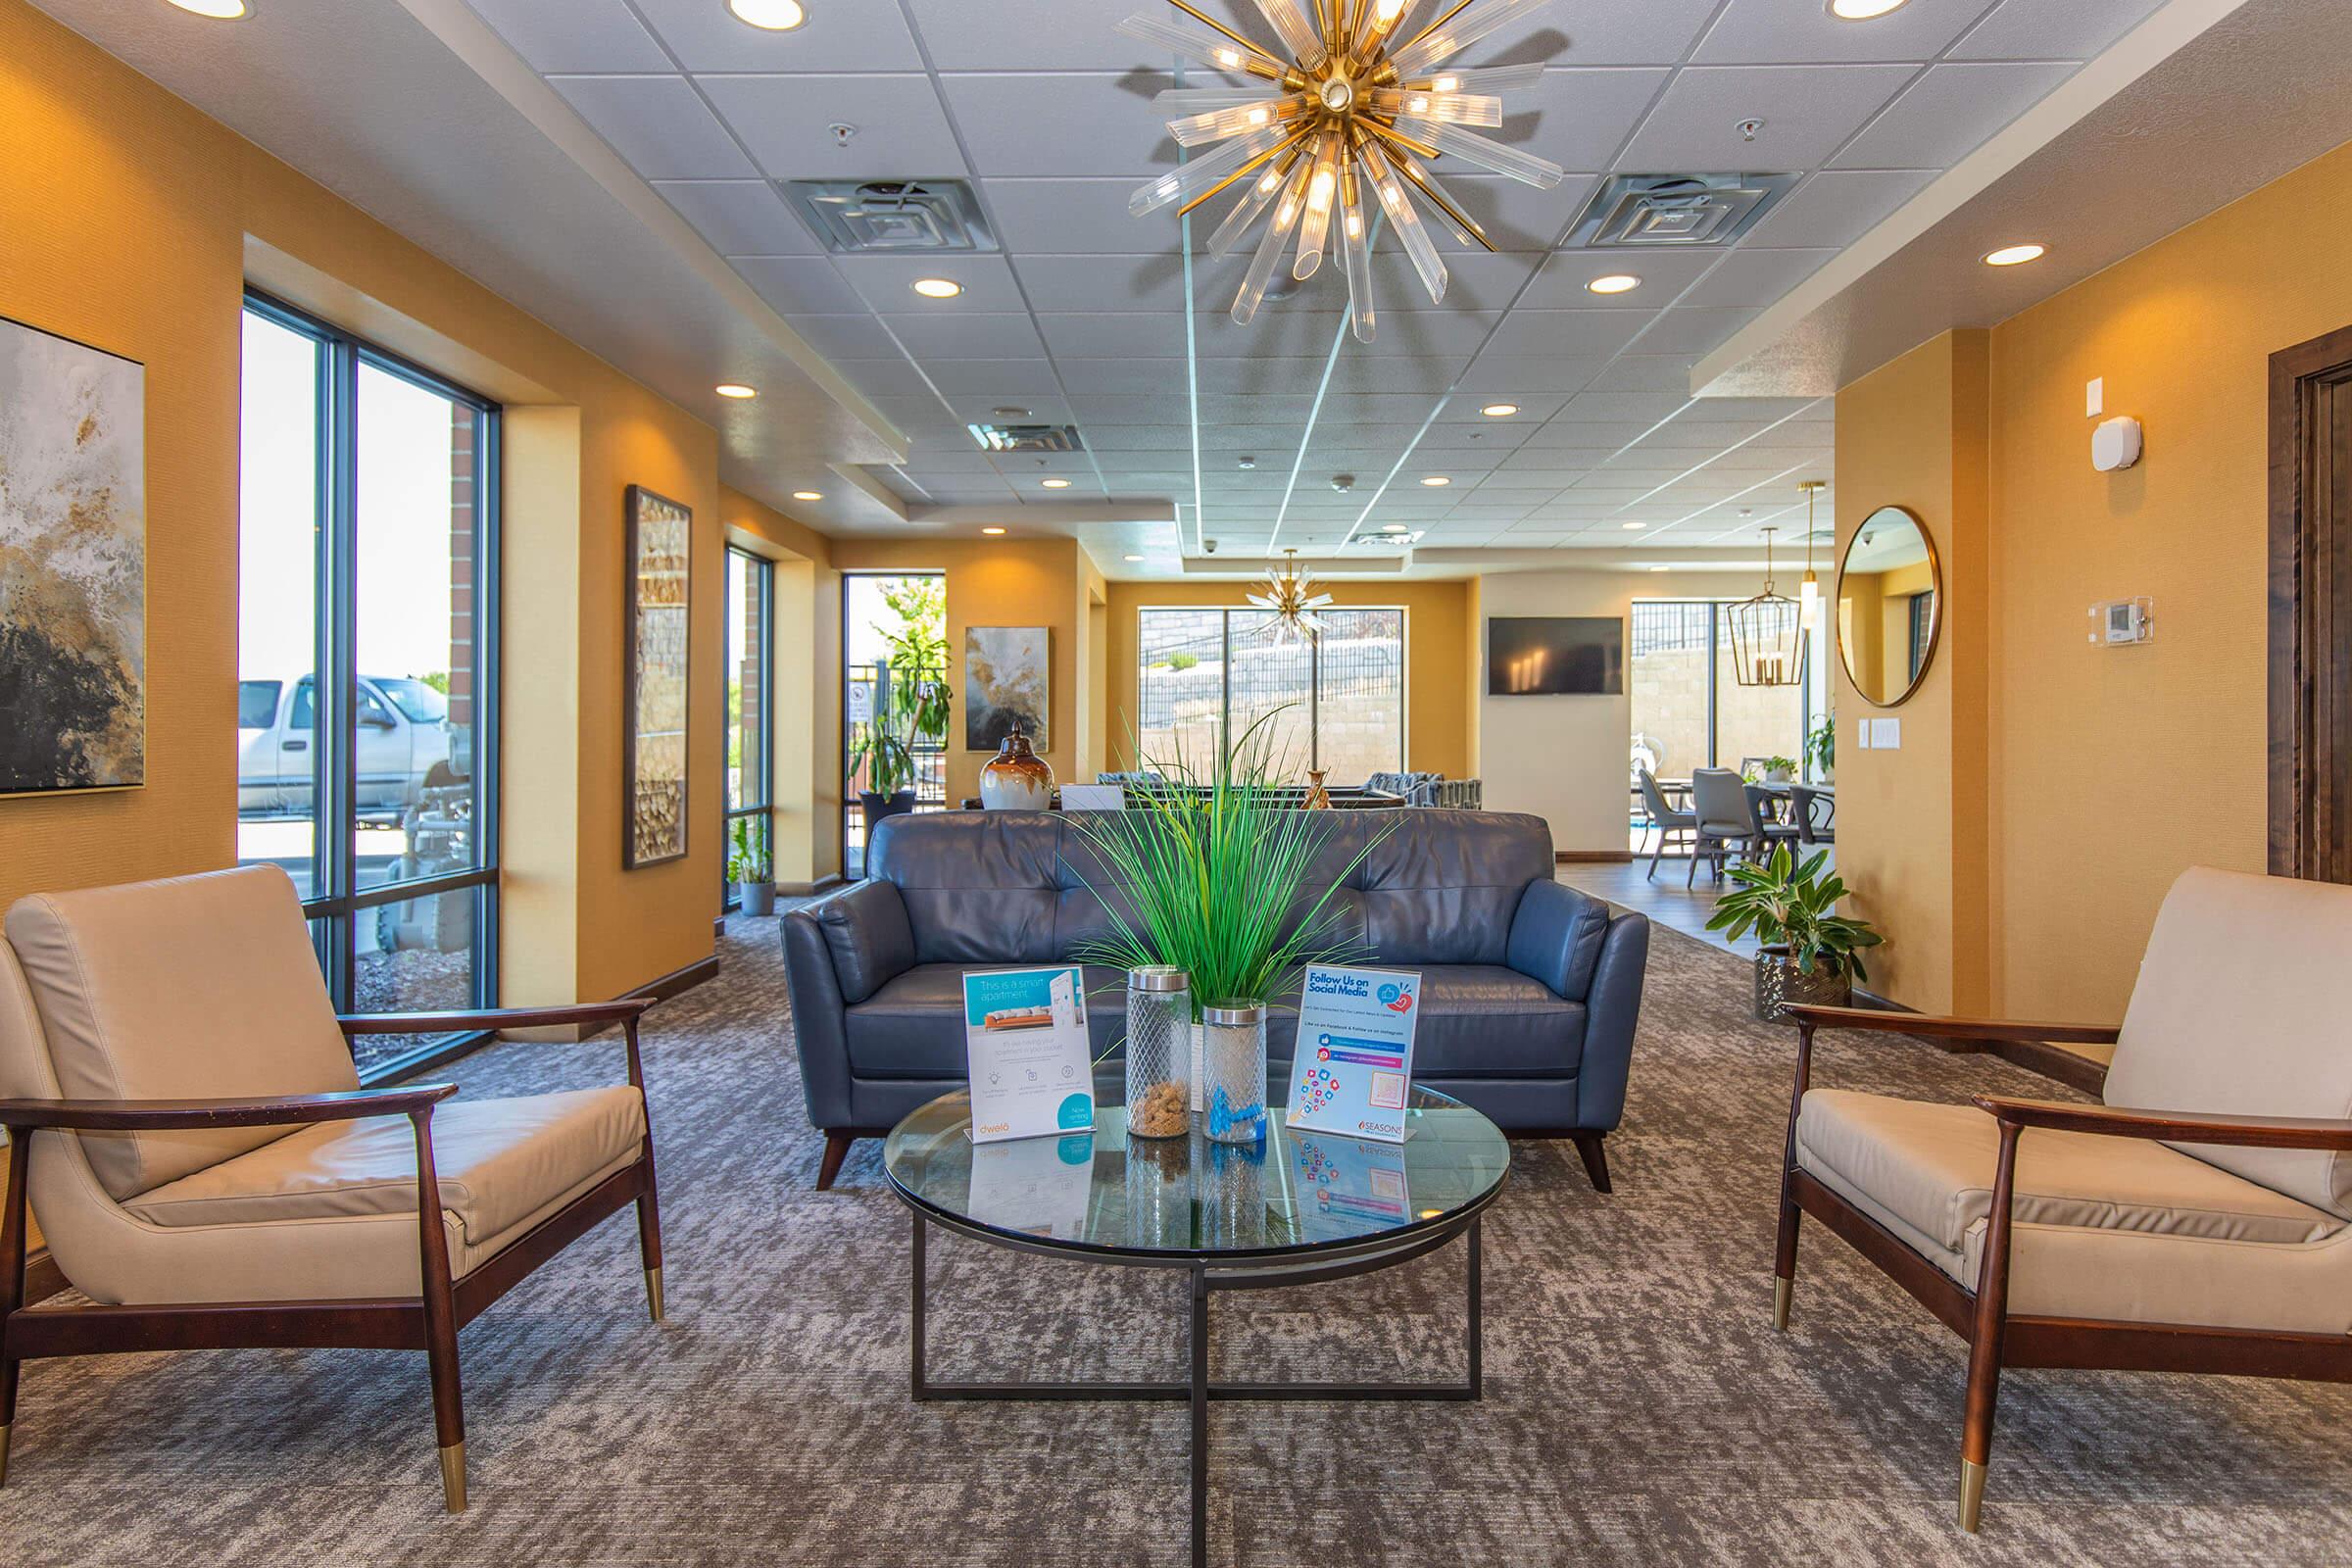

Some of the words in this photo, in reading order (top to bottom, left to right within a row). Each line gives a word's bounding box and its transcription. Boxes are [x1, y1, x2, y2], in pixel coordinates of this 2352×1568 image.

[980, 980, 1000, 991] This
[1002, 980, 1009, 990] is
[1018, 978, 1044, 989] smart
[1309, 972, 1342, 984] Follow
[1343, 975, 1354, 986] Us
[1355, 978, 1369, 987] on
[980, 989, 1028, 1003] apartment
[1308, 983, 1338, 995] Social
[1338, 985, 1368, 997] Media
[1365, 1121, 1402, 1135] SEASONS
